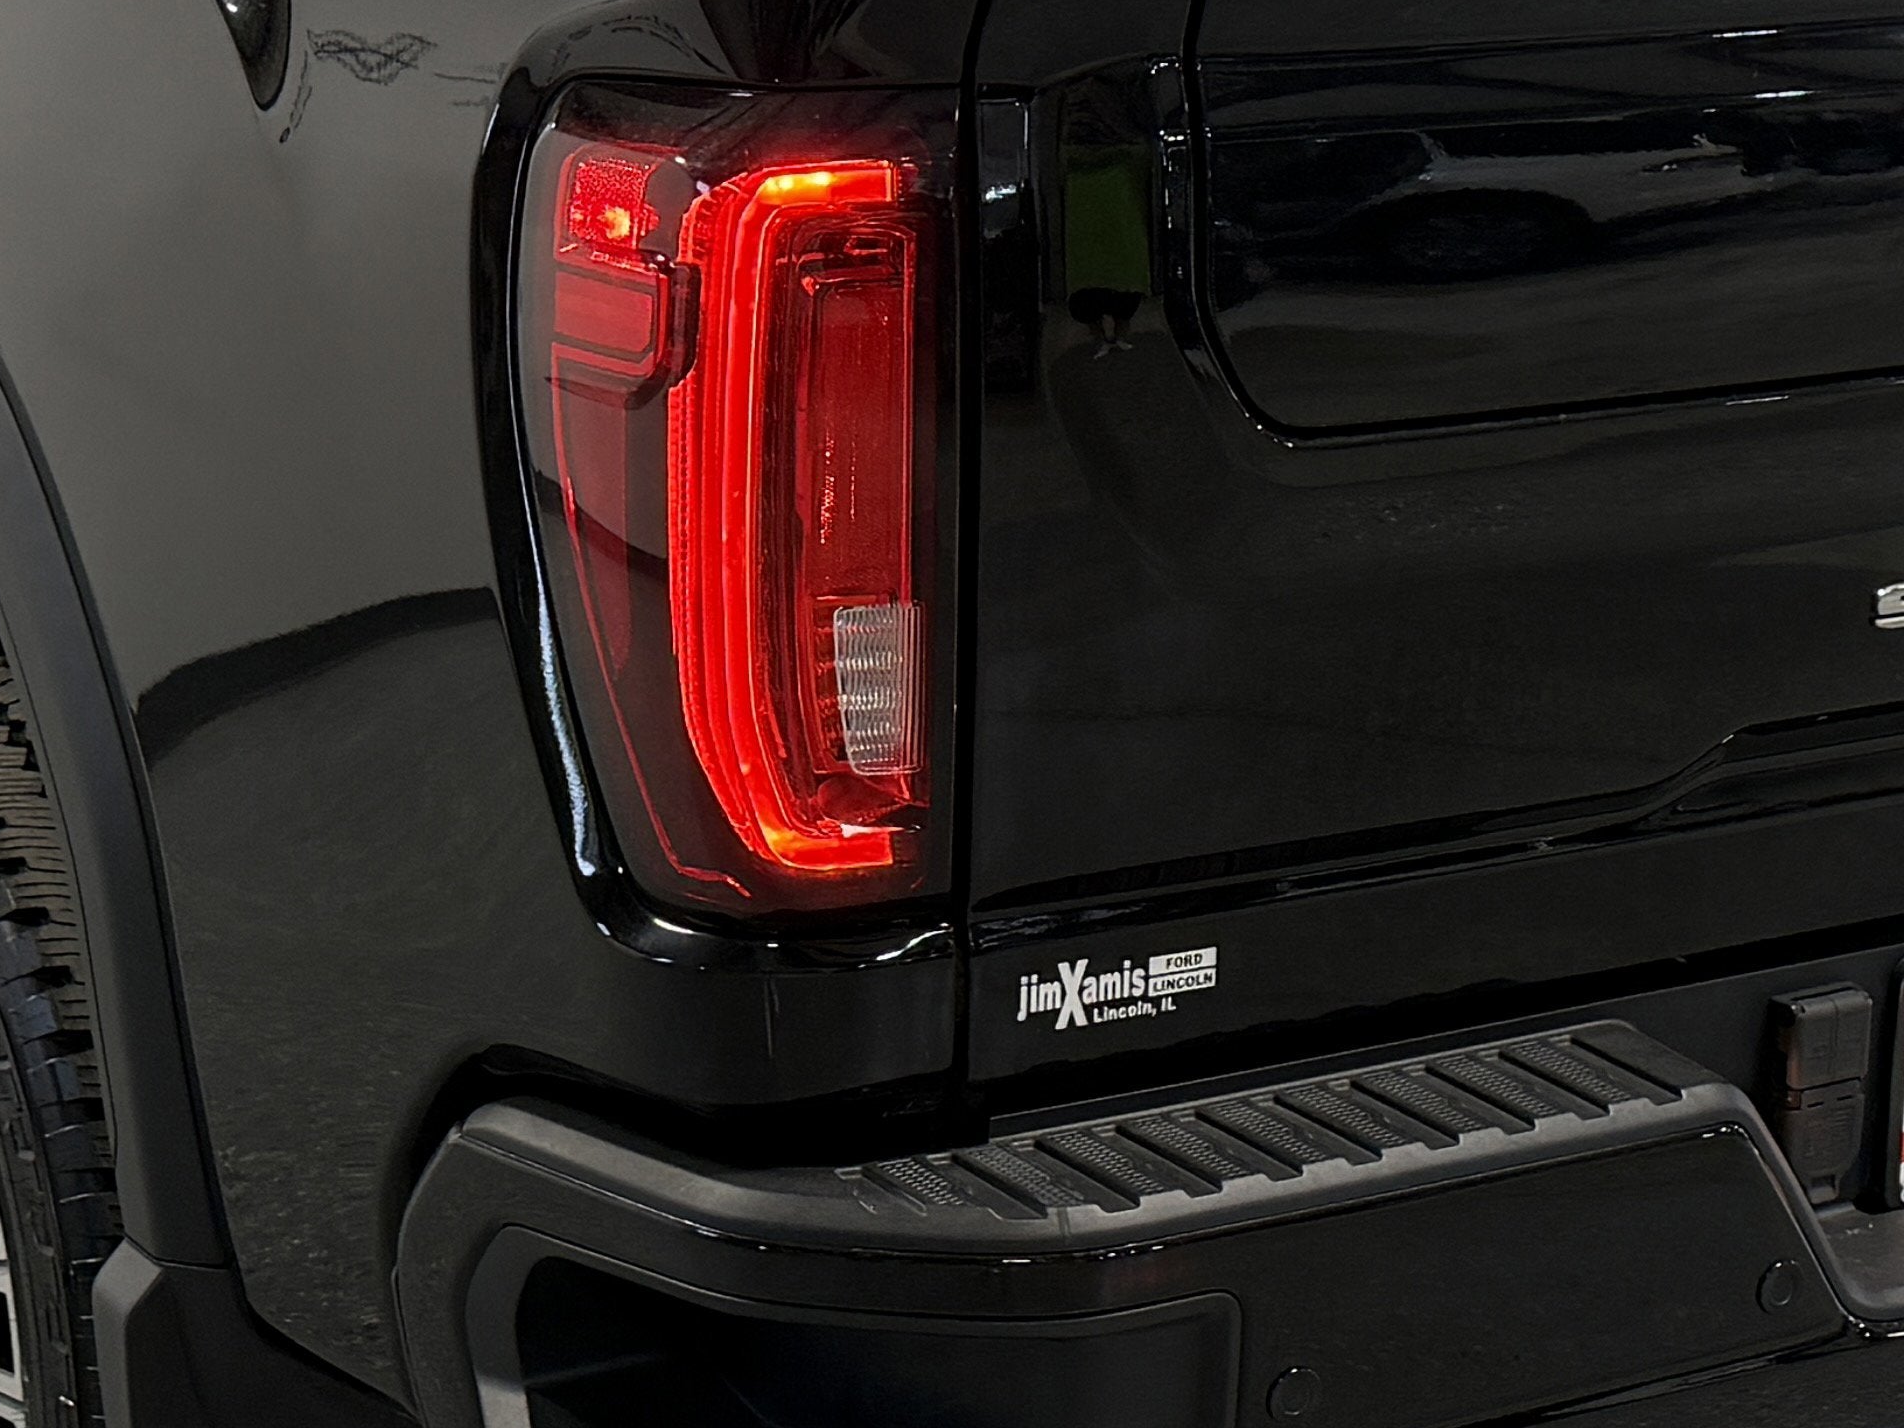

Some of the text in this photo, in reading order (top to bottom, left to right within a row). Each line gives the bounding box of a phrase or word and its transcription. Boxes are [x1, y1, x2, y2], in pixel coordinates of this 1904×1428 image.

[1165, 952, 1203, 970] FORD
[1016, 958, 1147, 1031] jimXamis
[1153, 973, 1213, 993] LINCOLN
[1093, 996, 1177, 1023] Lincoln, IL
